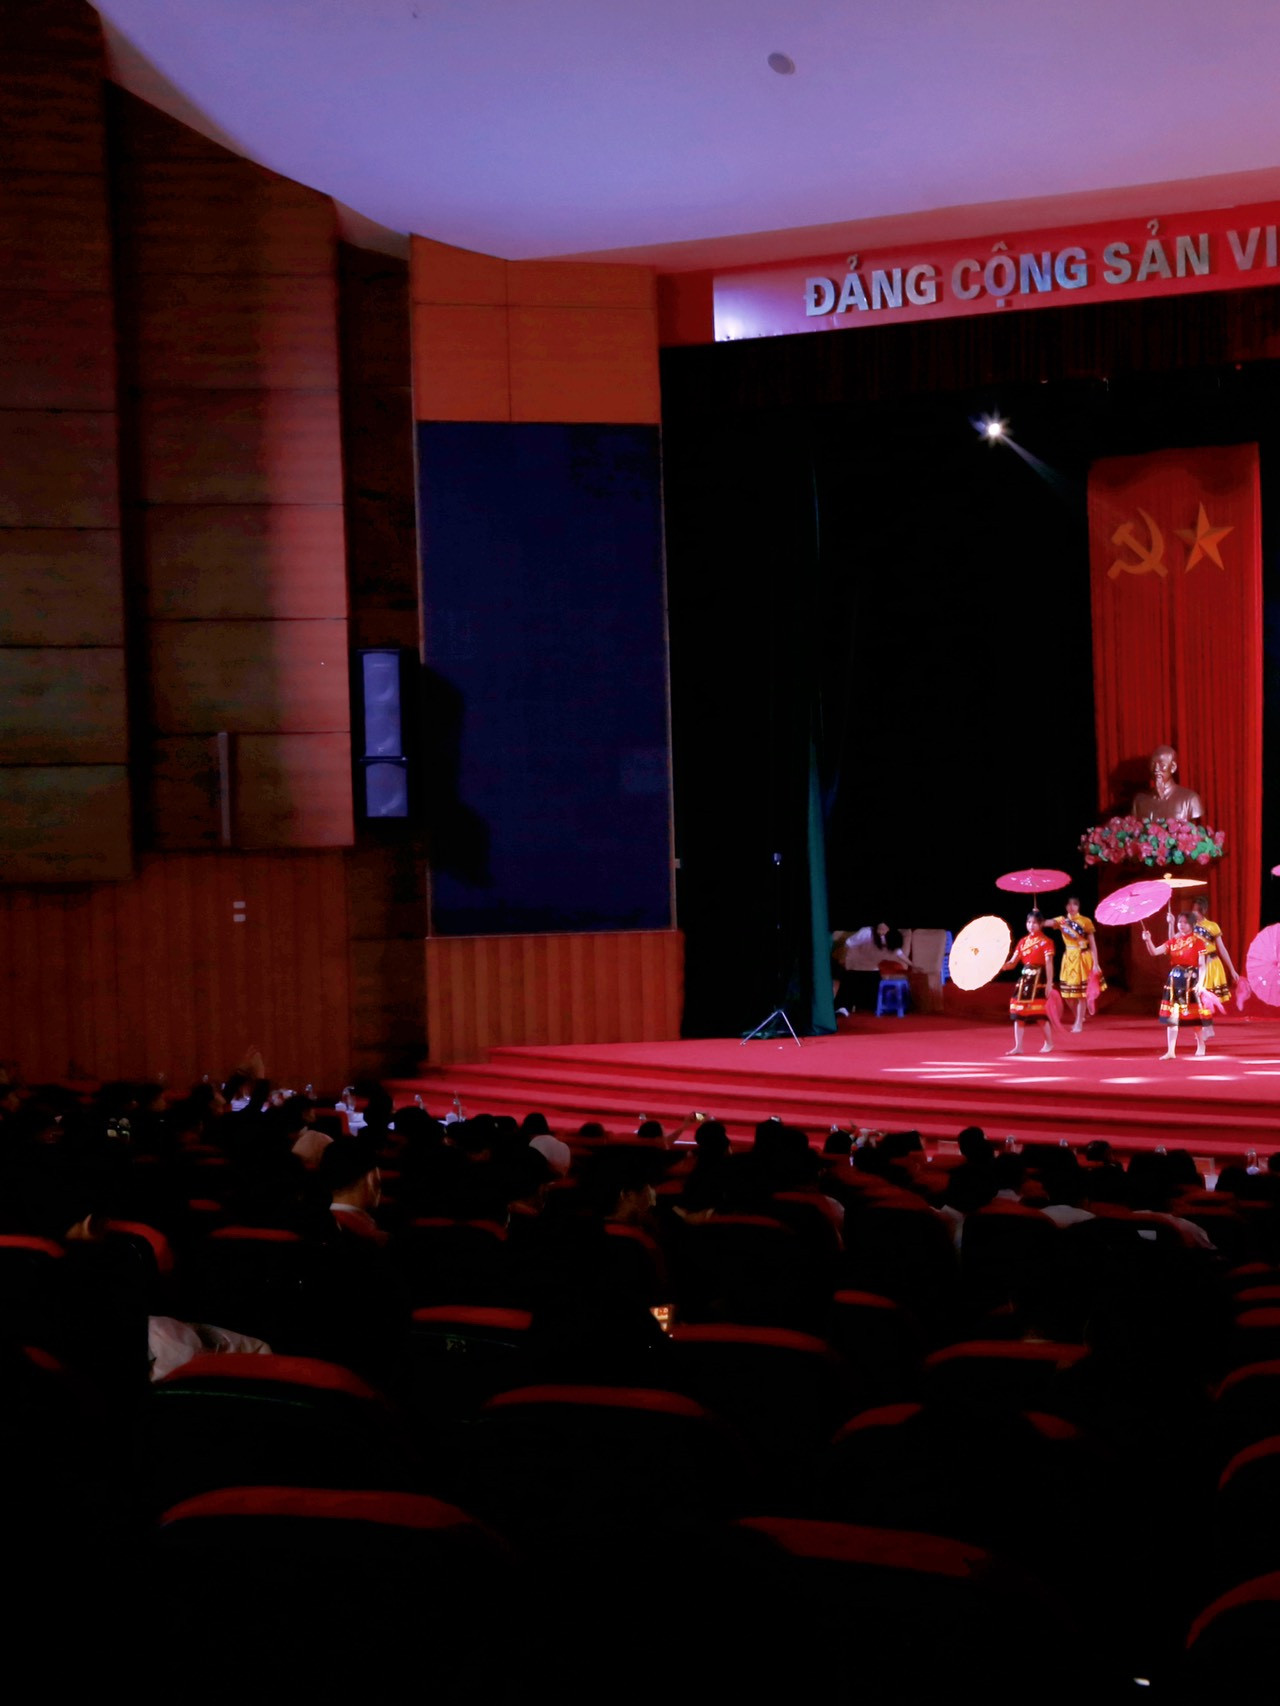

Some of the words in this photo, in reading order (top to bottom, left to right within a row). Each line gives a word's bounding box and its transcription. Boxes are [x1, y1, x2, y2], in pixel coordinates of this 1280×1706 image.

[804, 254, 937, 317] ĐẢNG
[950, 242, 1088, 308] CỘNG
[1102, 219, 1211, 285] SẢN
